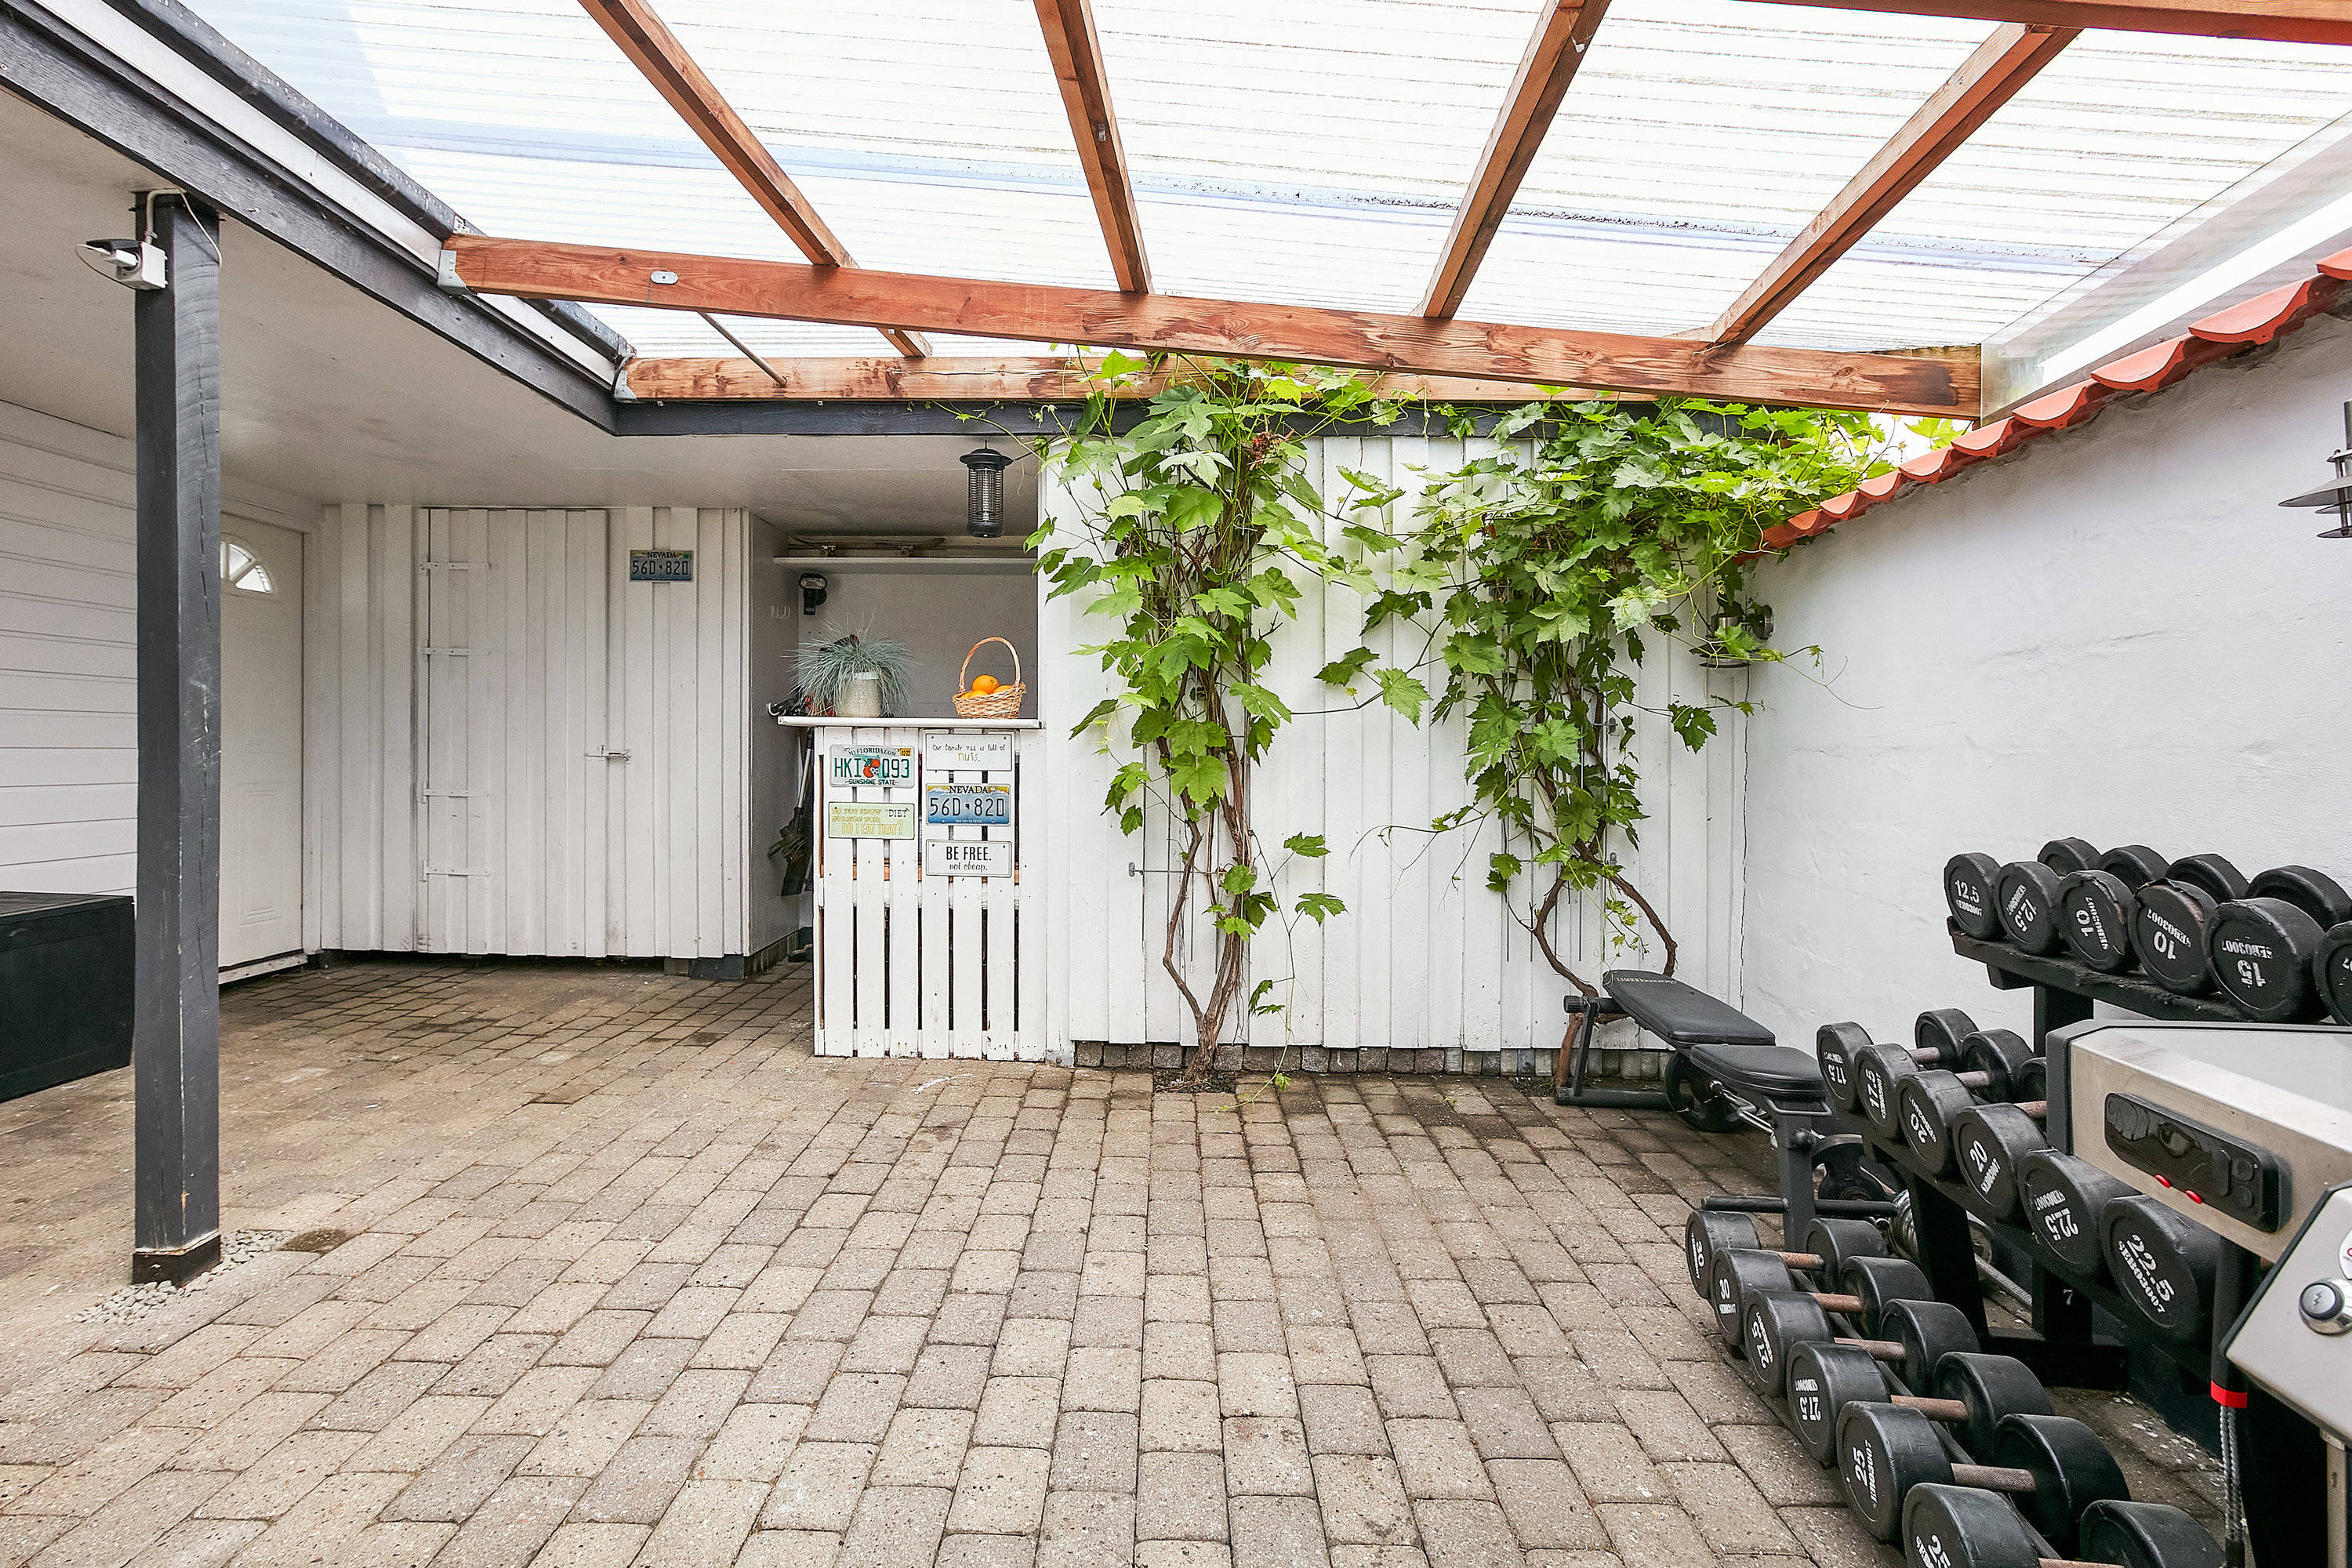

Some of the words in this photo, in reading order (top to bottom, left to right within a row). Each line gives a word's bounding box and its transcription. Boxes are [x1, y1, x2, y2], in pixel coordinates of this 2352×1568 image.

[633, 561, 655, 574] 56D
[666, 561, 688, 575] 820
[834, 758, 861, 778] HKI
[882, 759, 909, 778] Q93
[958, 753, 980, 762] nuts.
[930, 798, 960, 815] 56D
[975, 798, 1004, 816] 820
[842, 823, 853, 834] DO
[856, 823, 858, 834] I
[862, 824, 875, 834] EAT
[878, 820, 903, 835] THAT?
[946, 847, 959, 860] BE
[964, 847, 991, 861] FREE.
[964, 861, 988, 873] cheap.
[1955, 880, 1980, 903] 12.5
[2076, 909, 2094, 937] 10
[2154, 931, 2176, 960] 10
[2238, 960, 2267, 987] 15
[1866, 1069, 1879, 1109] 17.5
[1911, 1113, 1928, 1143] 20
[1970, 1140, 1987, 1173] 20
[1697, 1240, 1704, 1267] 30
[2127, 1234, 2175, 1301] 22.5
[1720, 1279, 1730, 1299] 30
[2063, 1289, 2073, 1305] 7
[1853, 1446, 1867, 1487] 25
